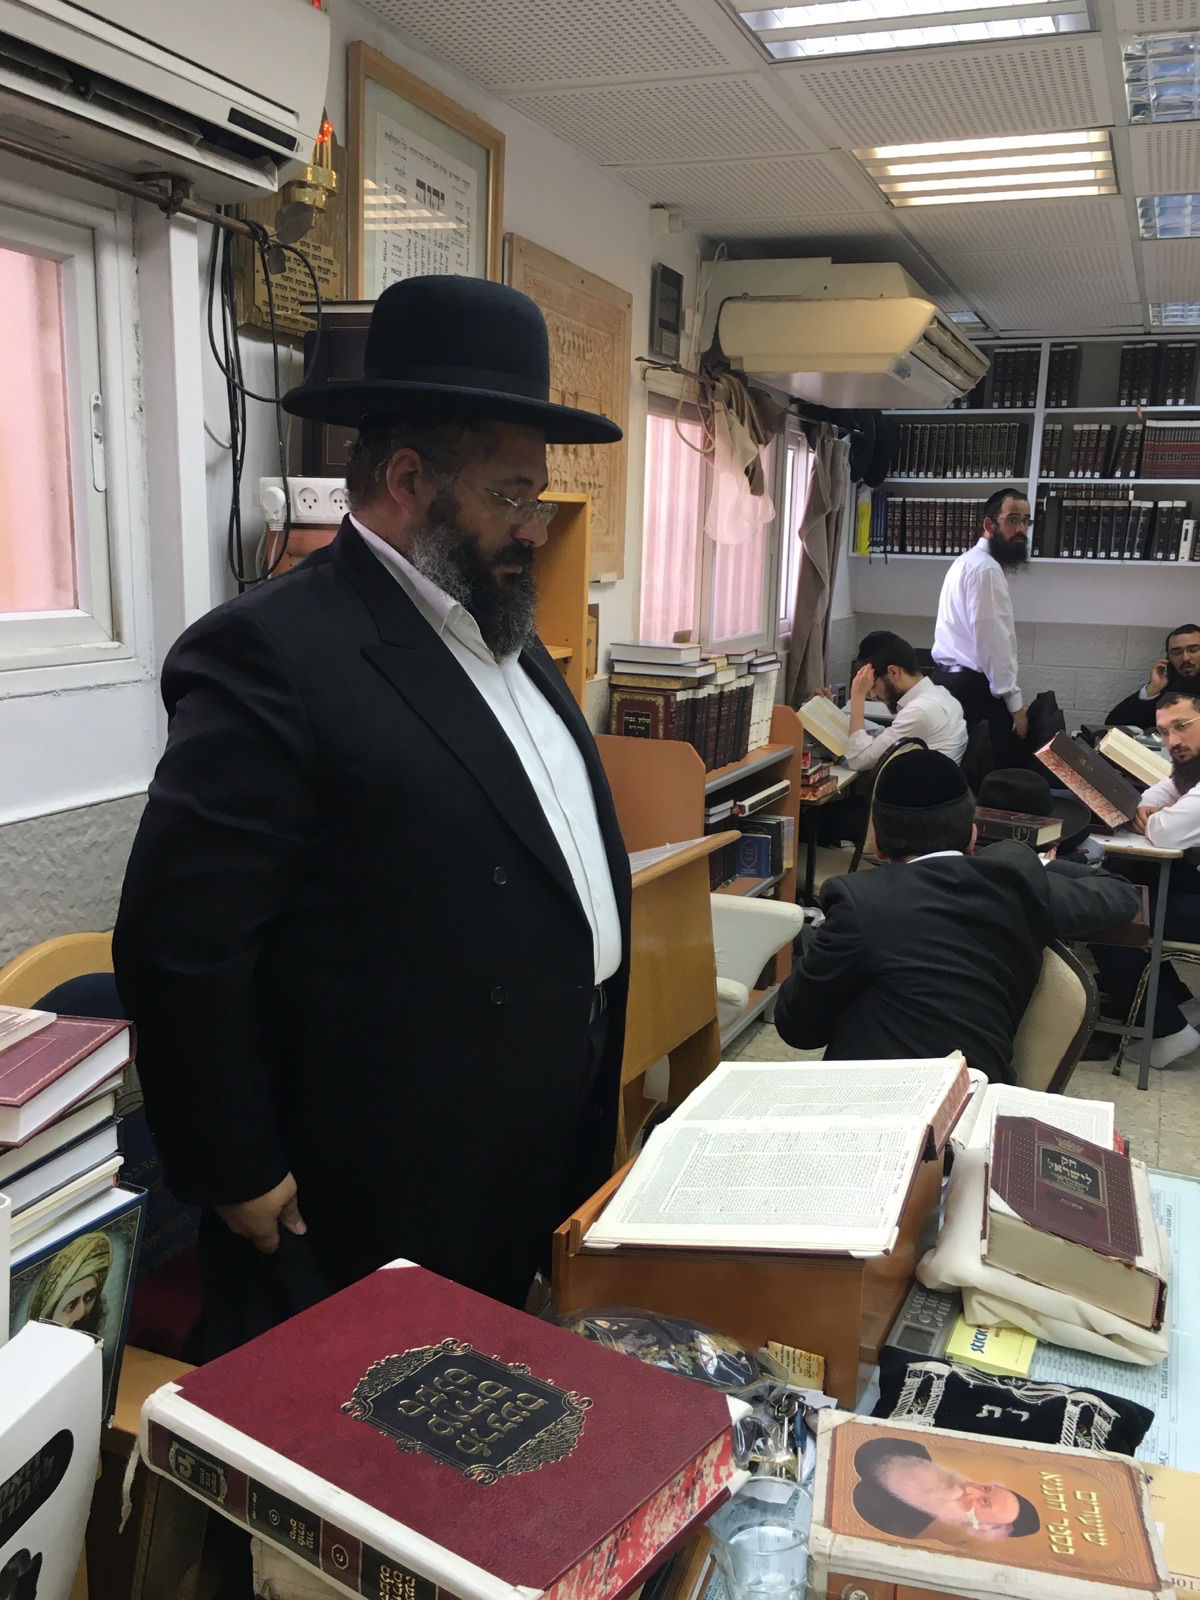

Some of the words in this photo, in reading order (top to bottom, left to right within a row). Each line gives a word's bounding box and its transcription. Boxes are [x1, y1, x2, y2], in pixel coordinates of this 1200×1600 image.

[1047, 1158, 1092, 1185] לישראל
[1060, 1156, 1077, 1169] חק
[397, 1367, 477, 1418] השלם
[427, 1379, 513, 1436] טורים
[455, 1392, 550, 1457] ארבעה
[1038, 1471, 1070, 1513] התניא
[289, 1518, 297, 1540] חיים
[1045, 1518, 1076, 1556] בספר
[1075, 1489, 1109, 1547] שיעורים
